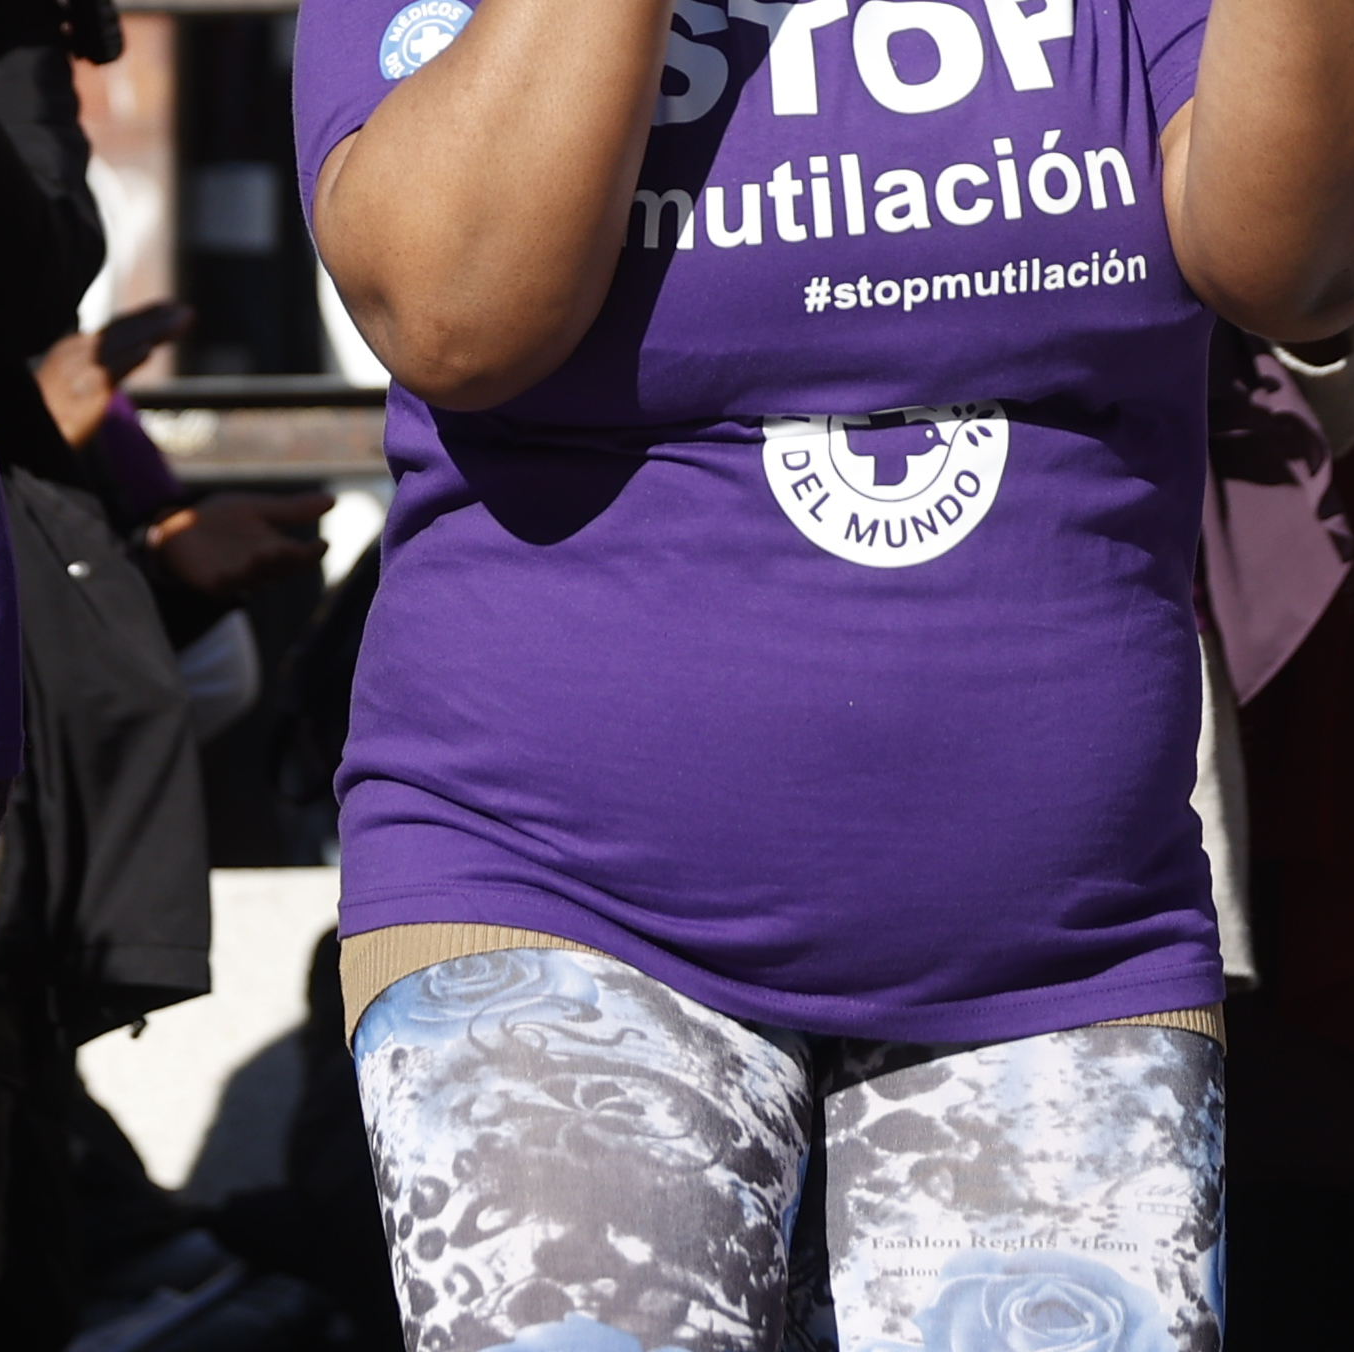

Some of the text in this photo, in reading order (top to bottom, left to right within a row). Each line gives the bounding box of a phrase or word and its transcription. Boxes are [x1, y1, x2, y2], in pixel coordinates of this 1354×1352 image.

[388, 1, 463, 42] MÉDICOS
[385, 52, 405, 79] DE
[630, 129, 1136, 251] mutilación
[804, 248, 1147, 313] #stopmutilación
[781, 450, 981, 549] DEL MUNDO
